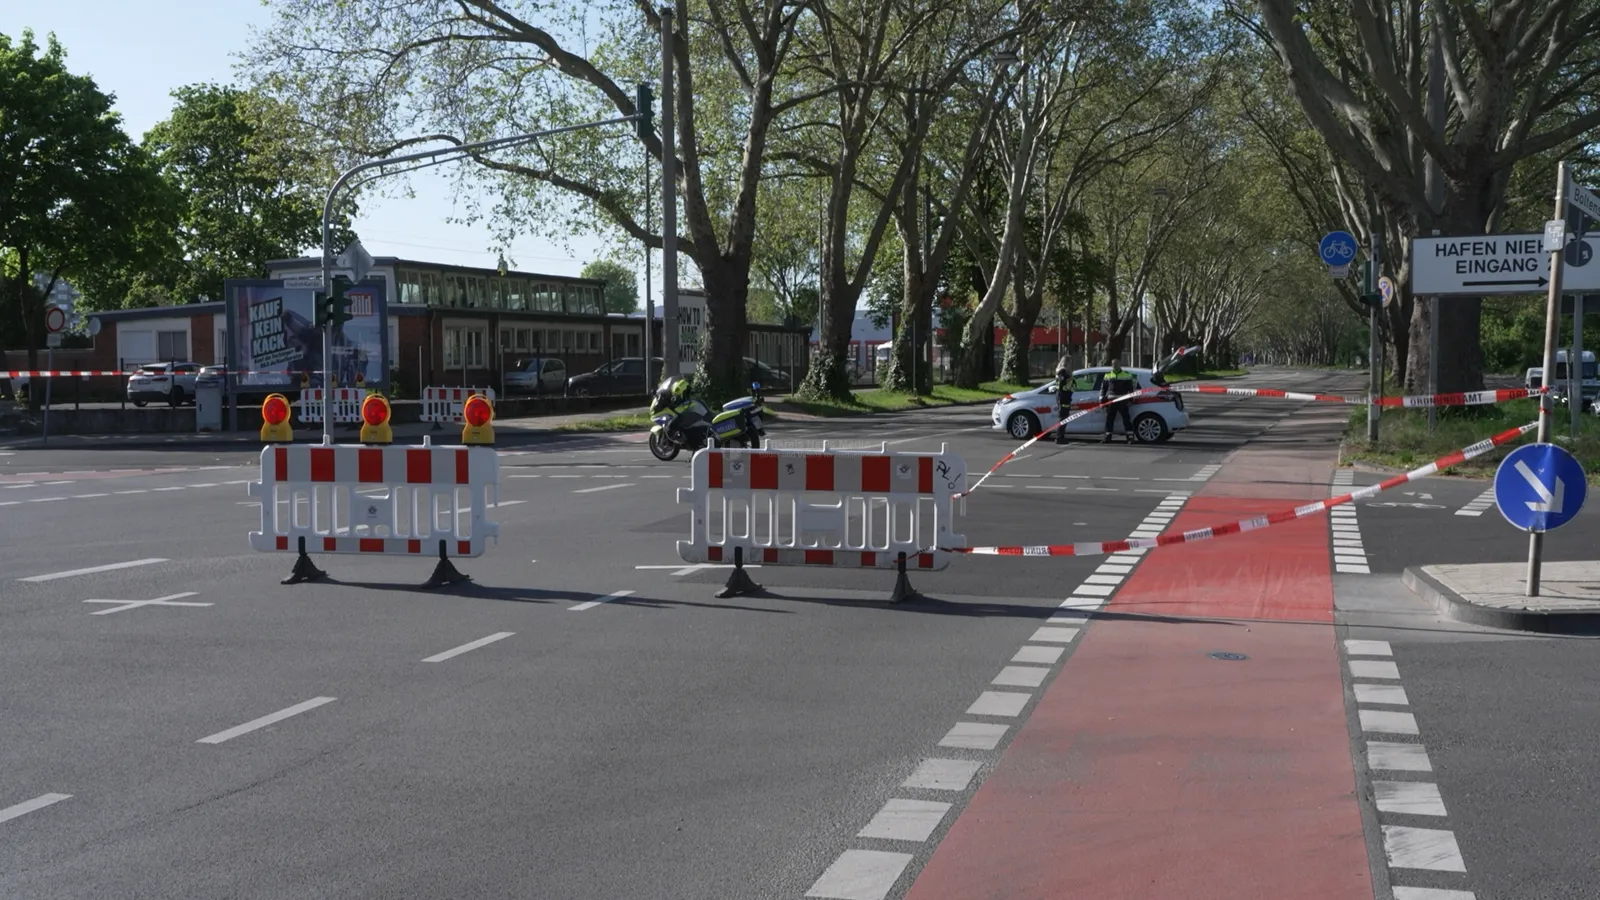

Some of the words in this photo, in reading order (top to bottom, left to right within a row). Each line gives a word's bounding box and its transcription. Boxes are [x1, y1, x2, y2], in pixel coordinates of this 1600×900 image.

[1435, 241, 1496, 257] HAFEN
[1456, 257, 1538, 274] EINGANG
[249, 300, 281, 322] KAUF
[693, 307, 701, 326] TO
[254, 316, 282, 338] KEIN
[253, 333, 285, 355] KACK
[716, 423, 736, 433] POLIZEI
